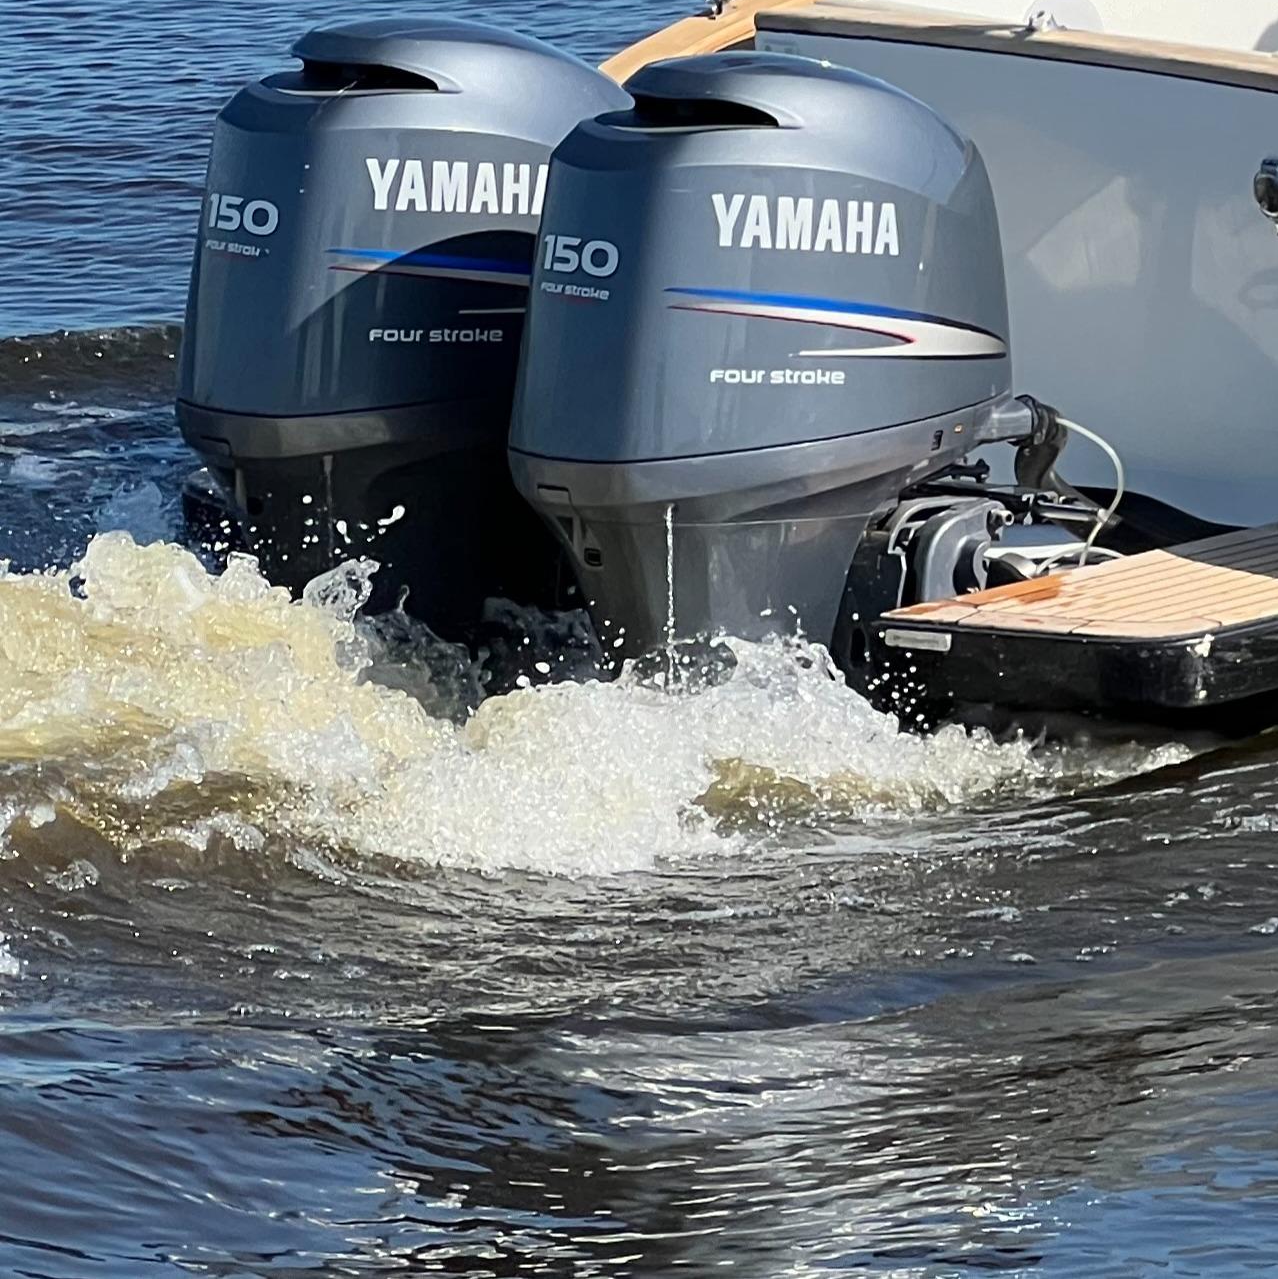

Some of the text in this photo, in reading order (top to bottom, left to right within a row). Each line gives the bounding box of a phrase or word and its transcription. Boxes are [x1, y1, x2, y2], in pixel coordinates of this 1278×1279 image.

[208, 193, 279, 236] 150
[711, 193, 900, 256] YAMAHA
[543, 234, 619, 278] 150
[428, 329, 504, 343] stroke
[770, 369, 846, 385] stroke
